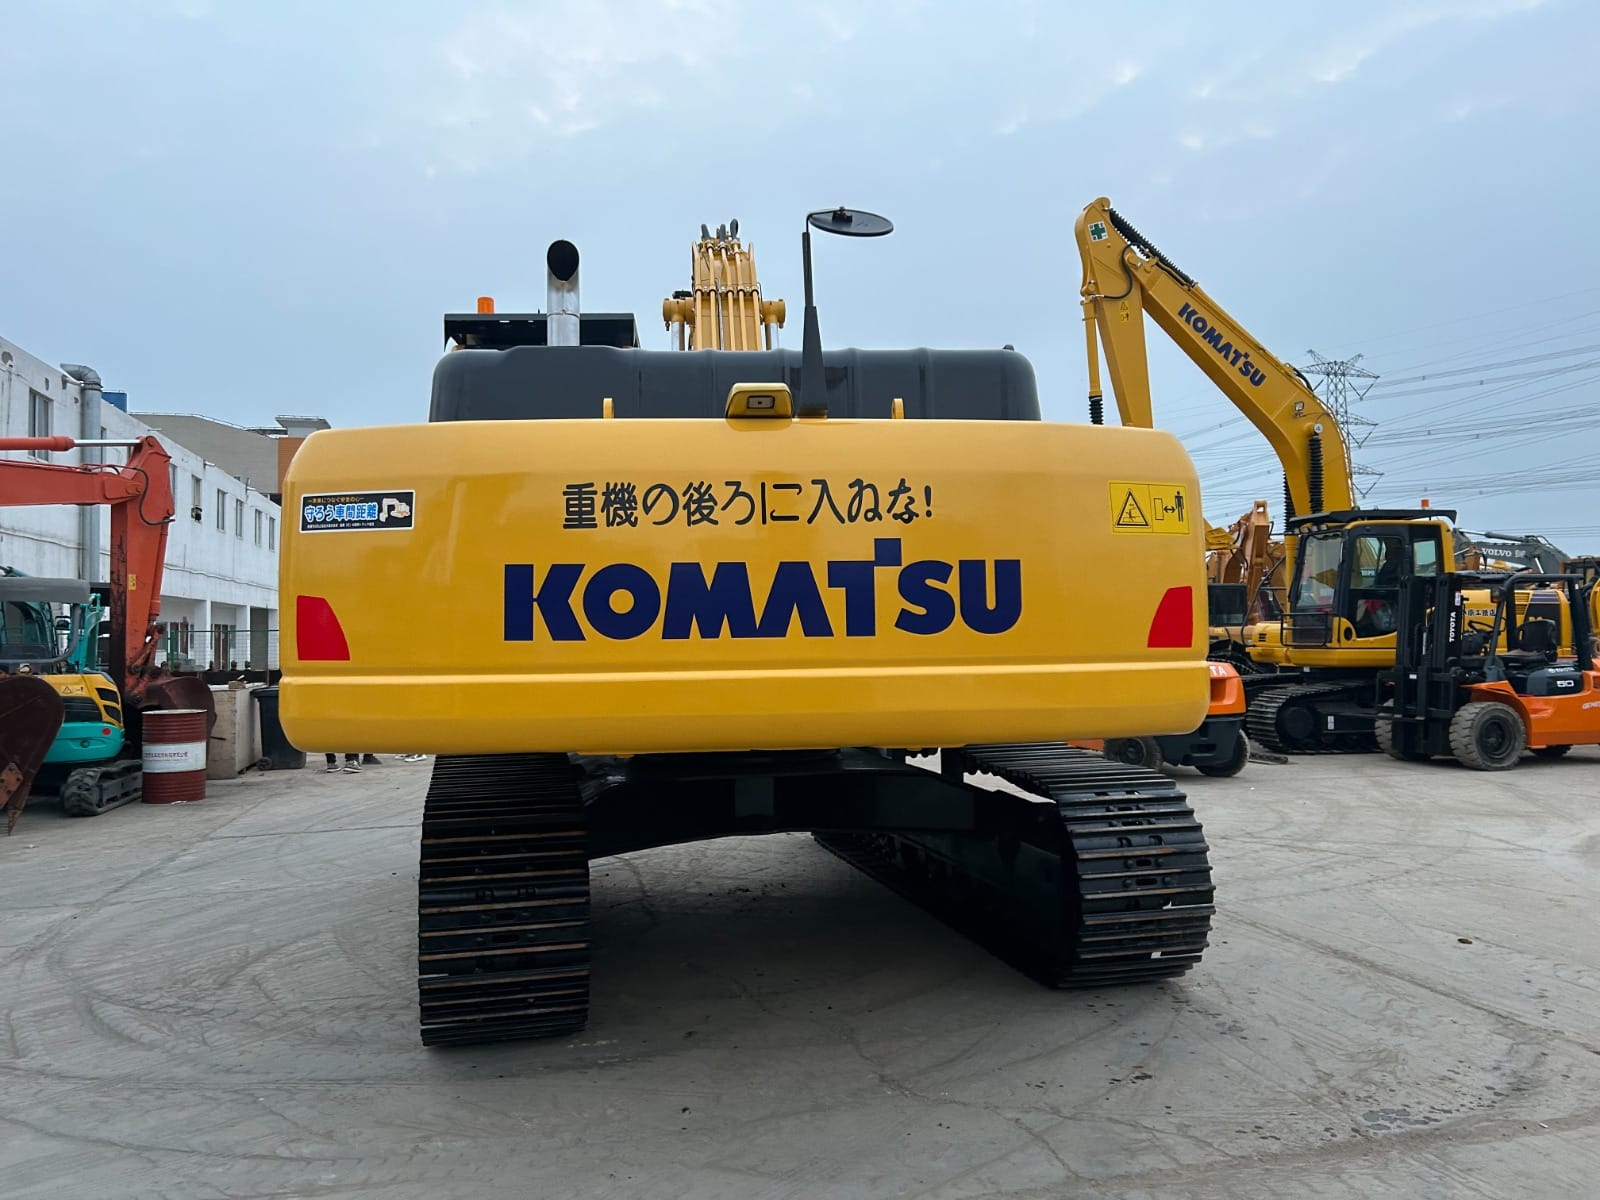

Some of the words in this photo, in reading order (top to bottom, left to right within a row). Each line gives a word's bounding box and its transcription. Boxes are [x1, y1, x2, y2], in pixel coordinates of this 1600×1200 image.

[1178, 302, 1267, 387] KOMATSU
[304, 502, 378, 522] 守ろう車間距離
[1481, 547, 1512, 557] VOLVO
[503, 537, 1022, 642] KOMATSU
[1449, 611, 1457, 643] TOYOTA
[1556, 680, 1574, 688] 50
